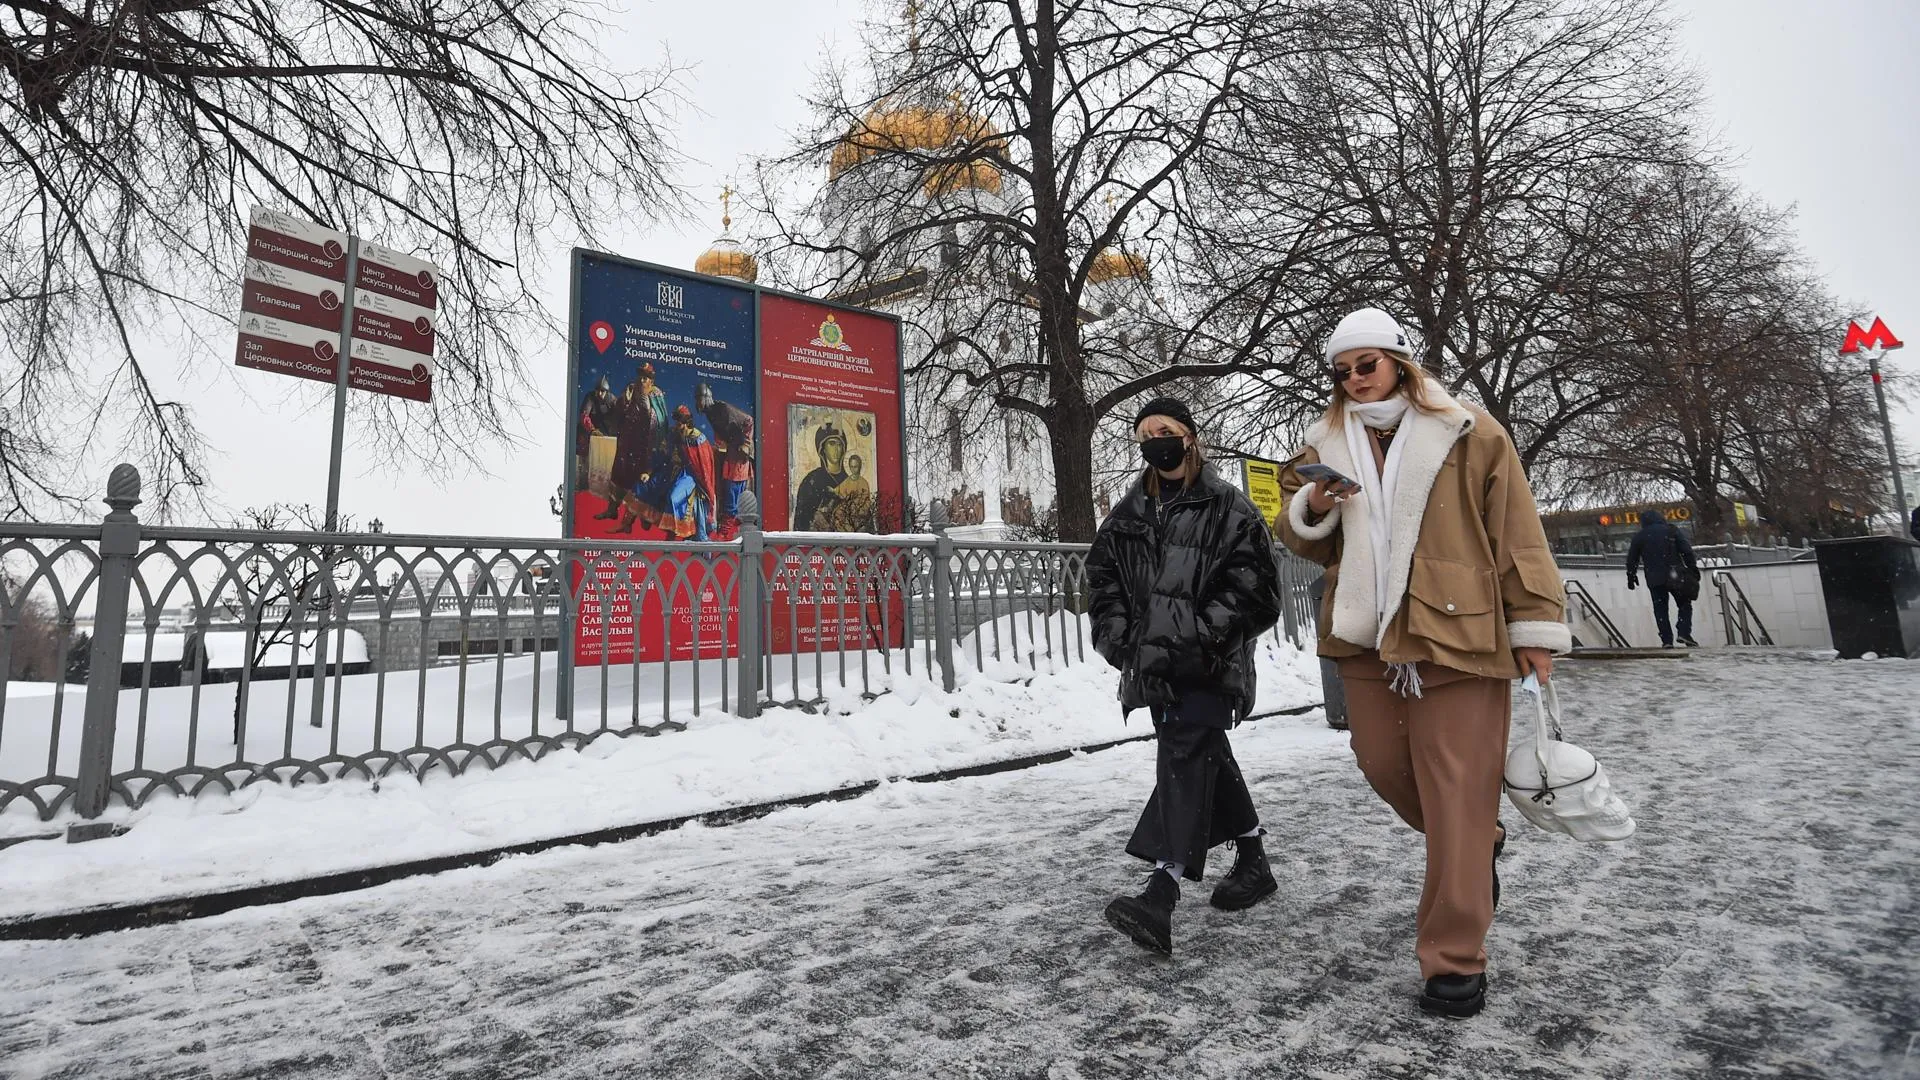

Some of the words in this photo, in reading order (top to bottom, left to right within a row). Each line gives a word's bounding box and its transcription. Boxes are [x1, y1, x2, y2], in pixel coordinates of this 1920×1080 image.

[254, 238, 309, 261] Патриарший
[310, 256, 334, 269] сквер
[362, 265, 386, 279] Центр
[361, 276, 393, 290] искусств
[394, 284, 420, 299] Москва
[255, 292, 301, 311] Трапезная
[358, 314, 391, 329] Главный
[358, 325, 376, 336] вход
[383, 330, 403, 341] Храм
[625, 324, 682, 342] Уникальная
[683, 336, 727, 349] выставка
[245, 340, 263, 351] Зал
[624, 337, 637, 346] на
[639, 339, 696, 355] территории
[244, 351, 294, 368] Церковных
[295, 361, 332, 375] Соборов
[624, 346, 658, 360] Храма
[658, 351, 693, 365] Христа
[694, 357, 743, 372] Спасителя
[792, 346, 844, 361] ПАТРИАРШИЙ
[845, 355, 869, 366] МУЗЕЙ
[353, 377, 384, 389] церковь
[354, 366, 416, 387] Преображенская
[582, 603, 628, 613] ЛЕВТАН
[582, 615, 633, 625] САВАСОВ
[582, 626, 633, 637] ВАСЛЬЕВ
